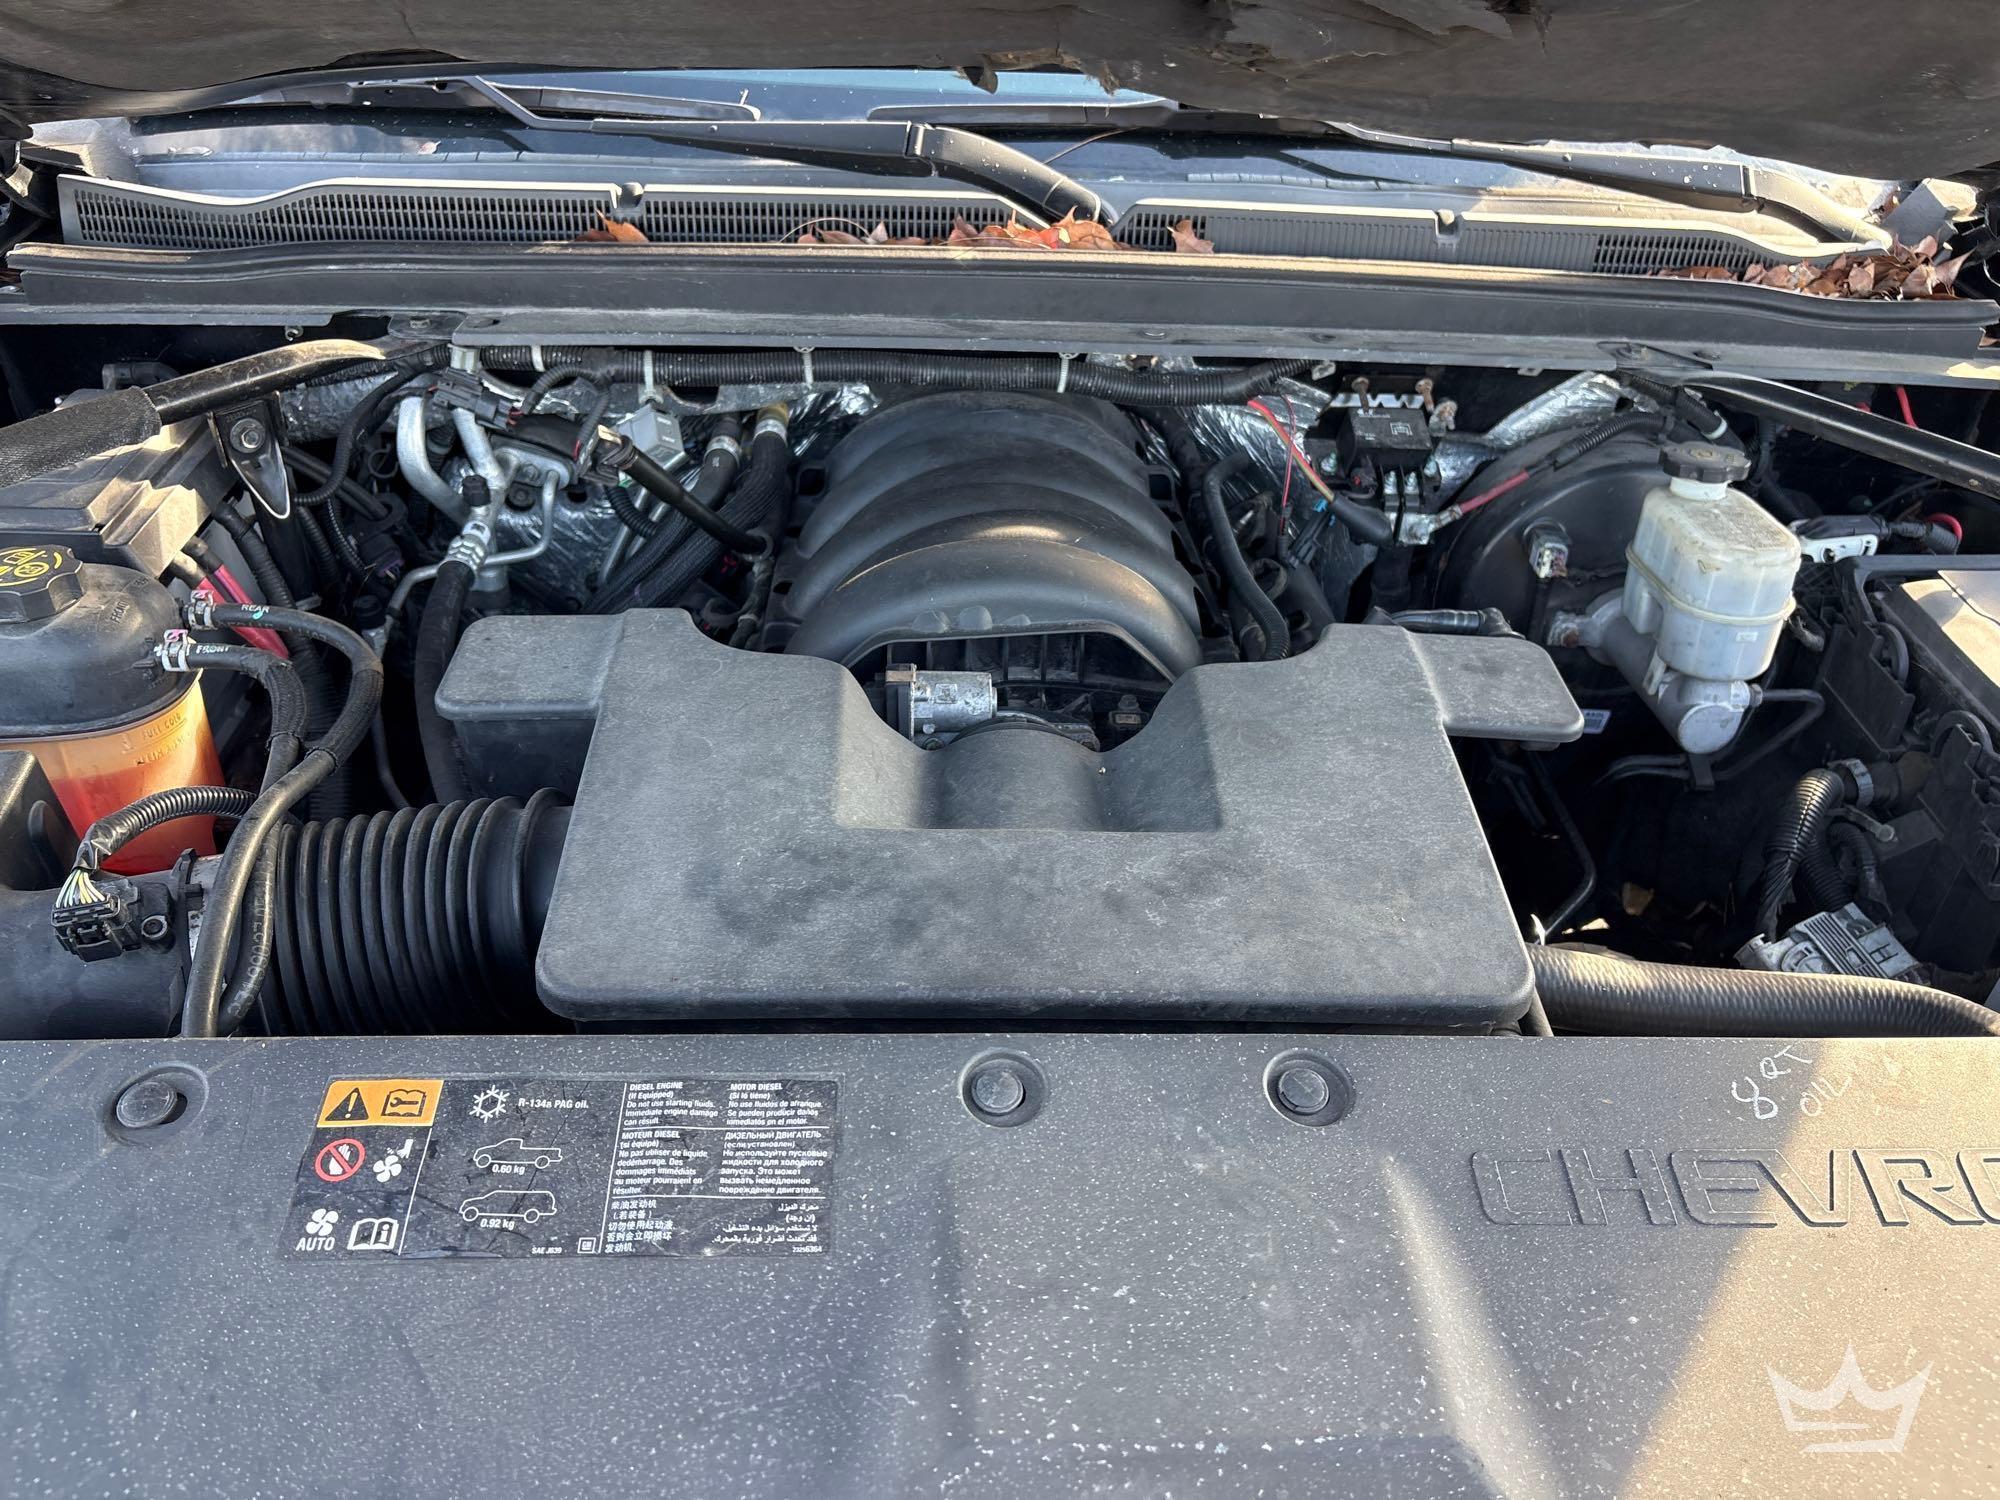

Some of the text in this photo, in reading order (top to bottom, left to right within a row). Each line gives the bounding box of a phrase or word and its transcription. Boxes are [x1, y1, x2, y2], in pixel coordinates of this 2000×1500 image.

[656, 1082, 683, 1090] ENGINE
[638, 1091, 674, 1100] Equipped)
[1731, 1076, 1778, 1119] 8
[1800, 1075, 1853, 1117] OIL
[518, 1098, 588, 1108] R-134a PAG oil.
[665, 1100, 692, 1108] starting
[690, 1109, 718, 1118] damage
[738, 1109, 765, 1117] pueden
[622, 1130, 680, 1139] MOTEUR DIESEL
[724, 1130, 822, 1140] ДИЗЕЛЬНЫЙ ДВИГАТЕЛЬ
[747, 1140, 795, 1149] установлен)
[492, 1164, 525, 1175] 0.60 kg
[616, 1167, 696, 1176] dommages immédiats
[720, 1168, 755, 1176] запуска.
[653, 1177, 692, 1185] pourraient
[719, 1186, 820, 1194] повреждение двигателя.
[480, 1218, 515, 1230] 0.92 kg
[296, 1237, 335, 1251] AUTO
